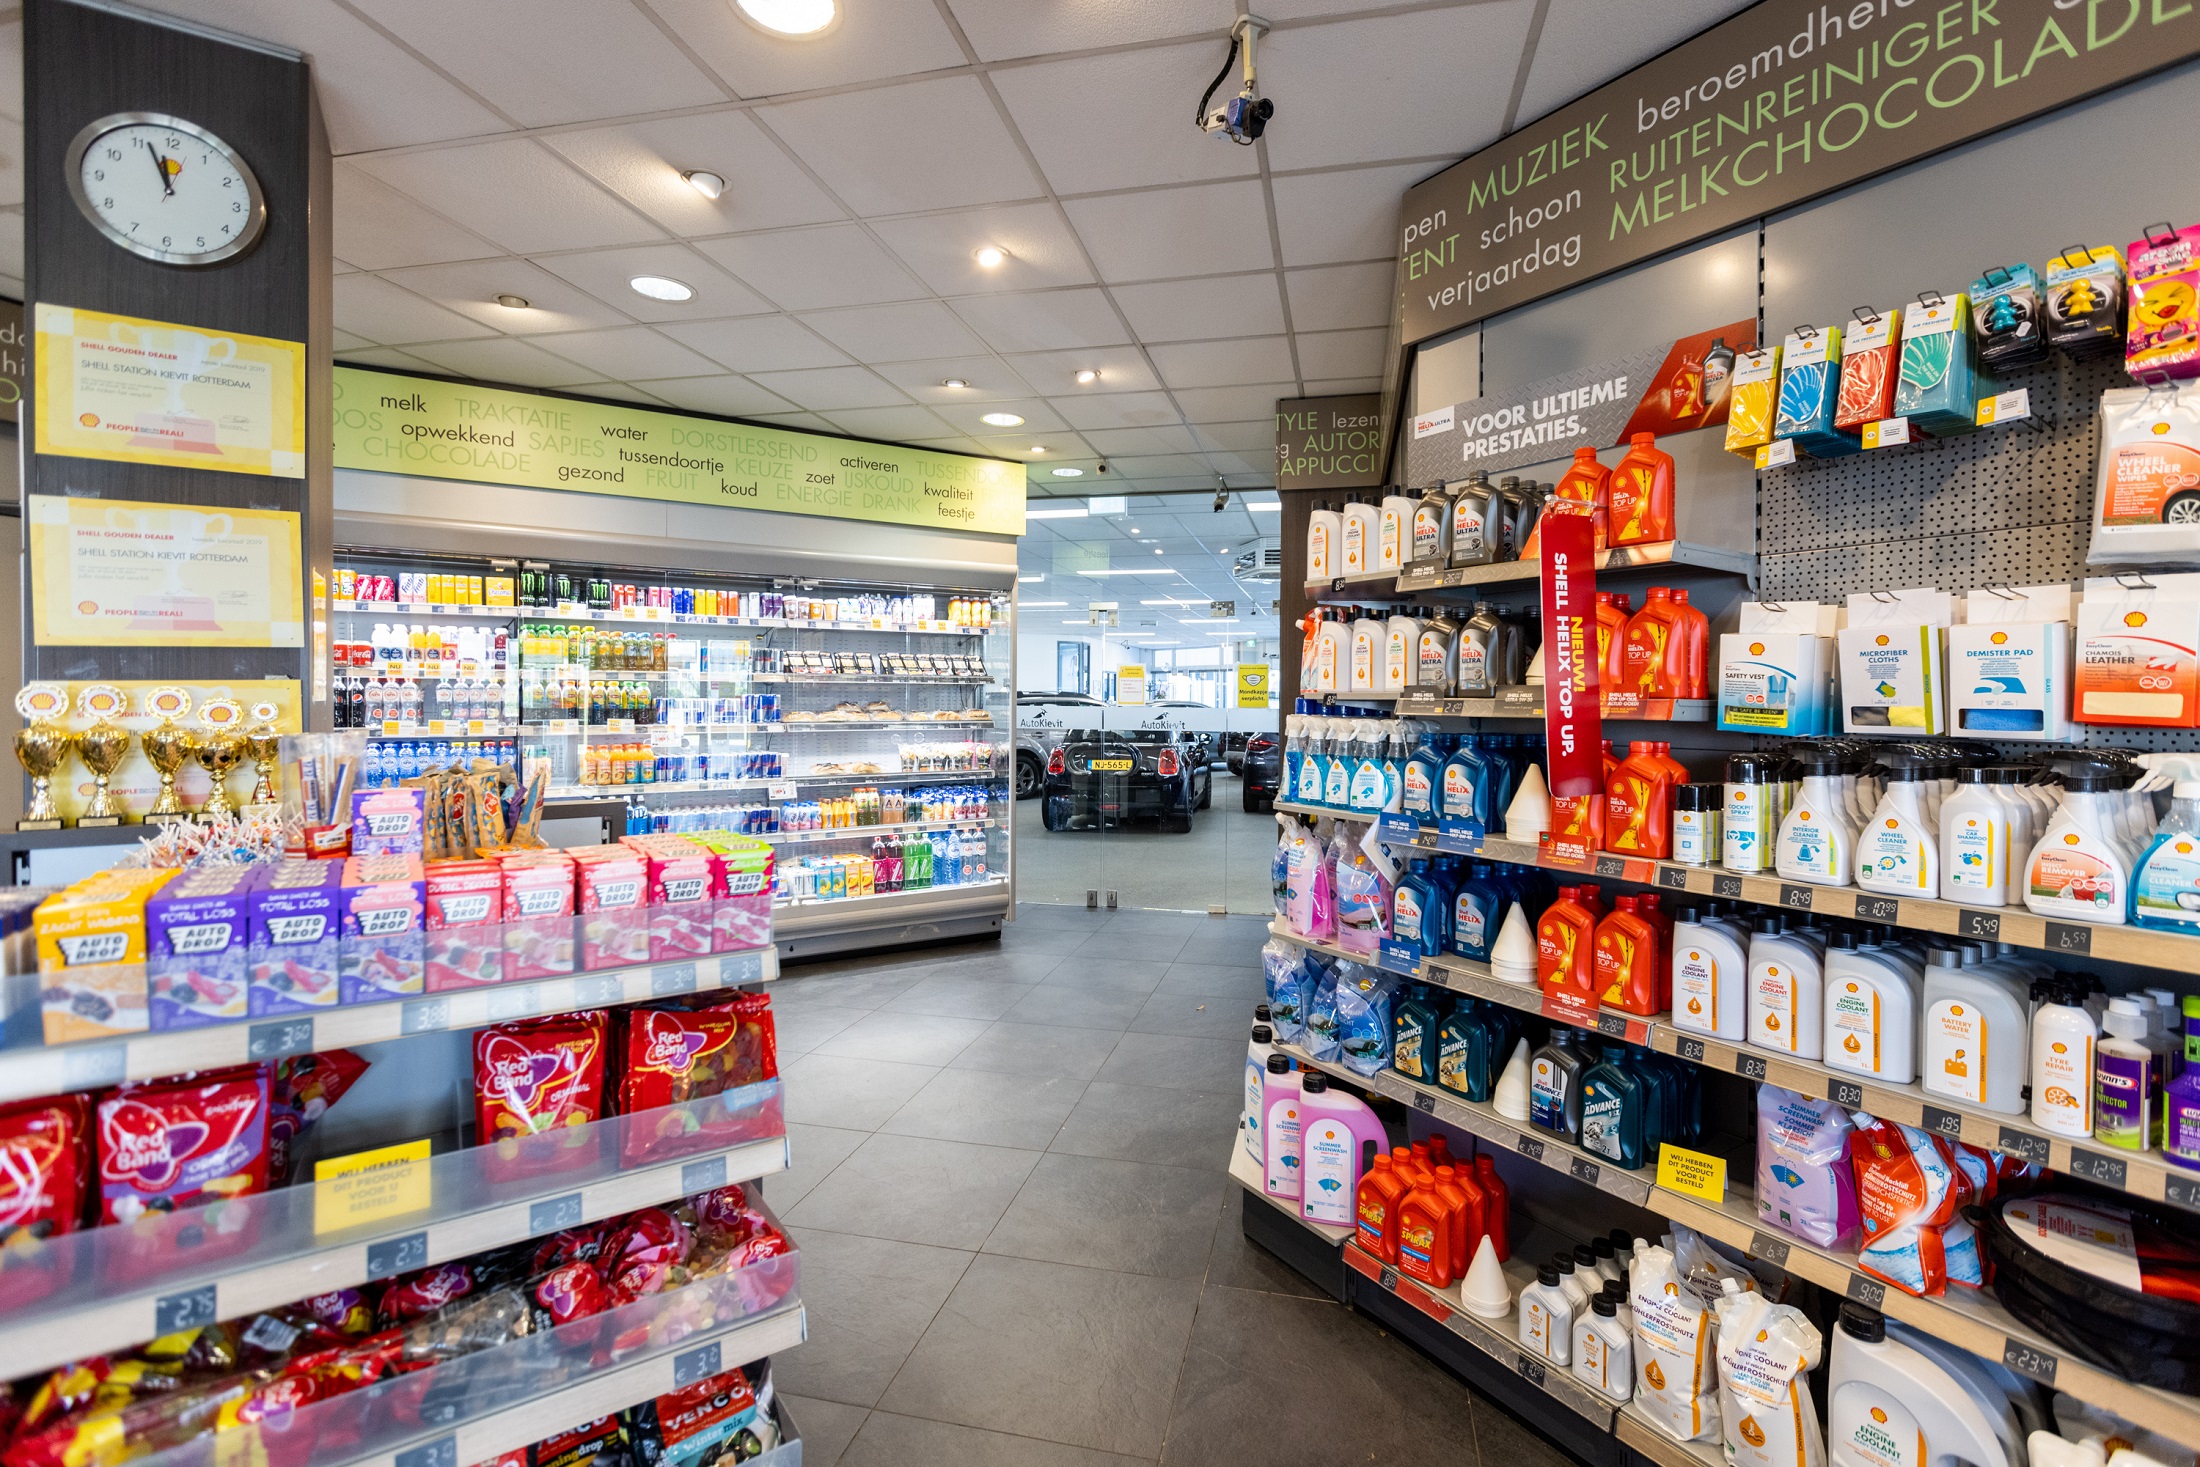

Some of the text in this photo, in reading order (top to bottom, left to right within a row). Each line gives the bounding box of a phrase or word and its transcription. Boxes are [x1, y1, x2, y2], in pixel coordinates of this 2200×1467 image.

[132, 137, 144, 149] 11
[165, 138, 180, 150] 12
[107, 149, 122, 161] 10
[202, 155, 207, 165] 1
[1467, 113, 1610, 215] MUZIEK
[95, 170, 104, 181] 9
[223, 177, 232, 187] 2
[104, 198, 114, 208] 8
[232, 202, 241, 212] 3
[1480, 189, 1582, 249] schoon
[131, 223, 139, 233] 7
[222, 224, 229, 234] 4
[163, 236, 171, 247] 6
[197, 236, 205, 247] 5
[1427, 234, 1582, 310] verjaardag
[81, 342, 178, 360] SHELL GOUDEN DEALER
[1800, 349, 1824, 357] FRESHENER
[81, 360, 250, 389] SHELL STATION KIEVIT ROTTERDAM
[381, 394, 427, 413] melk
[1462, 376, 1628, 437] VOOR ULTIEME
[454, 398, 571, 431] TRAKTATIE
[1333, 412, 1378, 428] lezen
[106, 423, 139, 432] PEOPLE
[1435, 418, 1450, 426] ULTRA
[401, 423, 514, 448] opwekkend
[601, 425, 648, 441] water
[1463, 416, 1588, 461] PRESTATIES.
[529, 432, 604, 458] SAPJES
[671, 428, 818, 462] DORSTLESSEND
[1304, 431, 1379, 452] AUTOR
[363, 437, 531, 473] CHOCOLADE
[619, 447, 724, 474] tussendoortje
[2118, 456, 2167, 467] WHEEL
[735, 458, 794, 480] KEUZE
[840, 456, 899, 473] activeren
[1276, 454, 1374, 476] APPUCCI
[2117, 464, 2181, 475] CLEANER
[558, 465, 624, 483] gezond
[646, 468, 699, 492] FRUIT
[806, 472, 835, 485] zoet
[2117, 474, 2147, 482] WIPES
[721, 479, 757, 497] koud
[924, 482, 973, 501] kwaliteit
[776, 484, 921, 514] ENERGIE DRANK
[1613, 497, 1637, 507] TOP UP
[938, 502, 975, 523] feestje
[1456, 519, 1480, 528] HELIX
[1416, 526, 1436, 535] HELIX
[1416, 533, 1435, 541] ULTRA
[1456, 526, 1479, 535] ULTRA
[78, 548, 248, 563] SHELL STATION KIEVIT ROTTERDAM
[1554, 552, 1575, 757] SHELL HELIX TOP UP.
[1570, 616, 1587, 693] NIEUW!
[1641, 651, 1652, 659] UP
[1966, 649, 2010, 657] DEMISTER
[1447, 786, 1471, 794] HELIX
[737, 874, 760, 883] AUTO
[2041, 867, 2086, 877] REMOVER
[734, 882, 760, 893] DROP
[535, 890, 560, 902] AUTO
[1790, 891, 1811, 906] 8.49
[526, 900, 561, 914] DROP
[285, 918, 320, 931] AUTO
[1972, 917, 1998, 935] 5.49
[280, 927, 317, 942] DROP
[1682, 970, 1708, 978] COOLANT
[1685, 965, 1706, 973] ENGINE
[1836, 1003, 1869, 1013] COOLANT
[1839, 998, 1865, 1006] ENGINE
[1941, 1017, 1972, 1028] BATTERY
[1944, 1024, 1969, 1033] WATER
[658, 1031, 684, 1044] Red
[655, 1041, 688, 1057] Band
[2045, 1062, 2073, 1072] REPAIR
[2048, 1056, 2069, 1065] TYRE
[1585, 1099, 1621, 1116] ADVANCE
[1790, 1103, 1821, 1118] SUMMER
[1778, 1105, 1825, 1126] SCREENWASH
[1784, 1116, 1815, 1131] SOMMER
[1668, 1160, 1714, 1177] DIT PRODUCT
[1685, 1157, 1713, 1169] HEBBEN
[1676, 1170, 1696, 1179] VOOR
[1675, 1177, 1704, 1189] BESTELD
[1401, 1229, 1431, 1249] SPIRAX
[666, 1385, 745, 1430] VENCO
